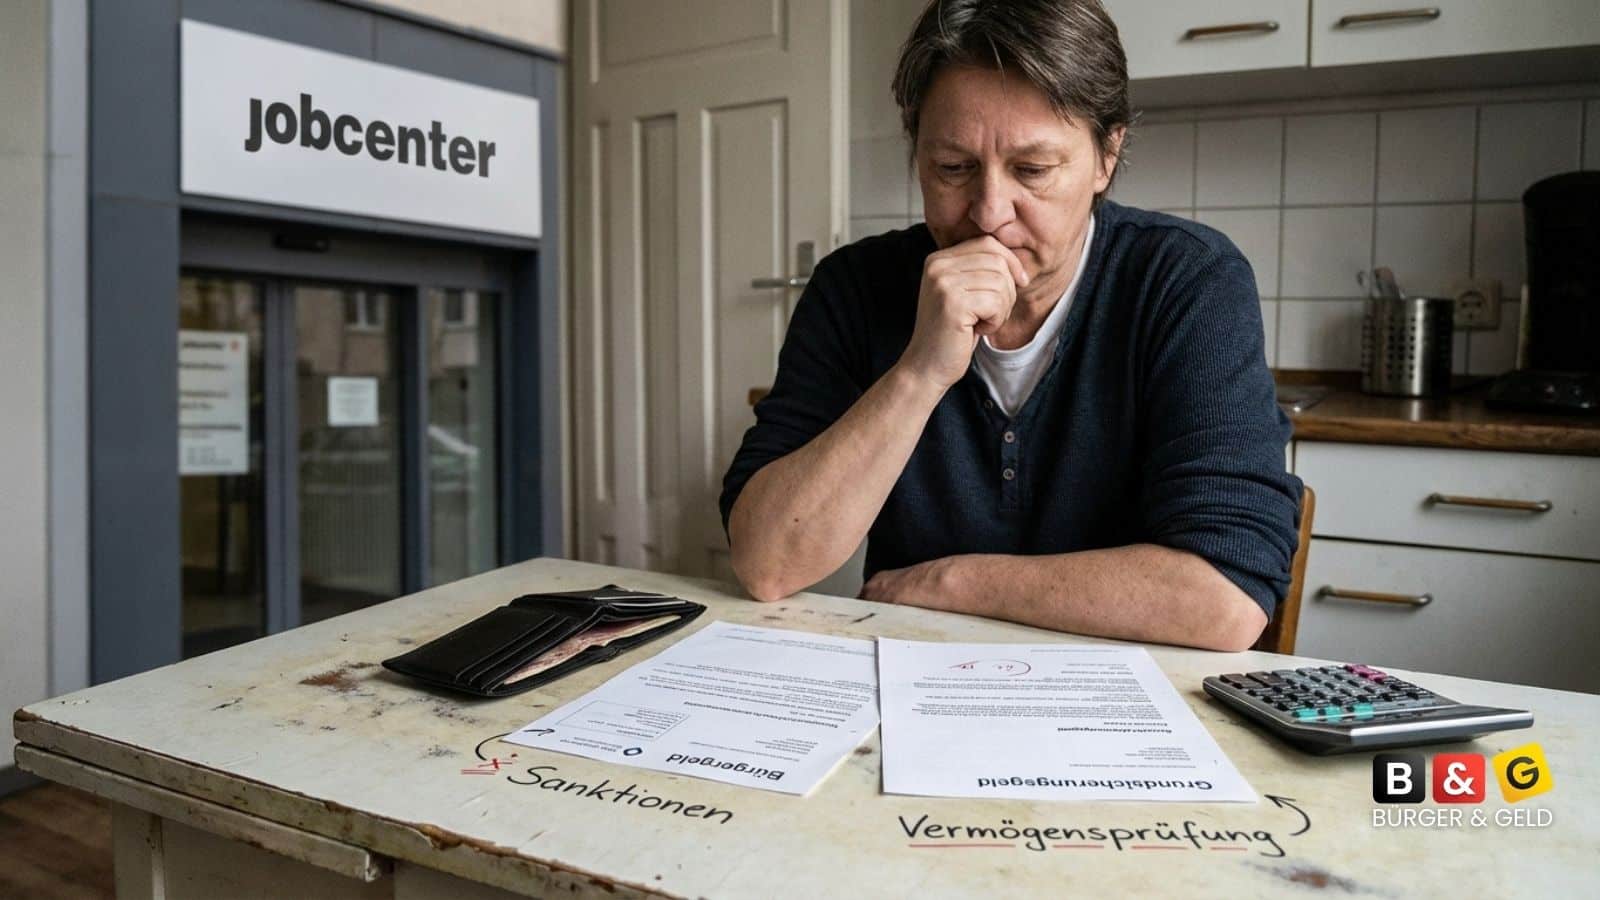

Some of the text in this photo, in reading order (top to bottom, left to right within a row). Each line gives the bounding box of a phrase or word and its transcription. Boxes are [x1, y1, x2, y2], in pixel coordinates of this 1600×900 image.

[506, 766, 734, 825] Sanktionen
[977, 776, 1213, 791] Grundsicherungsgeld
[898, 814, 1287, 858] Vermögensprüfung
